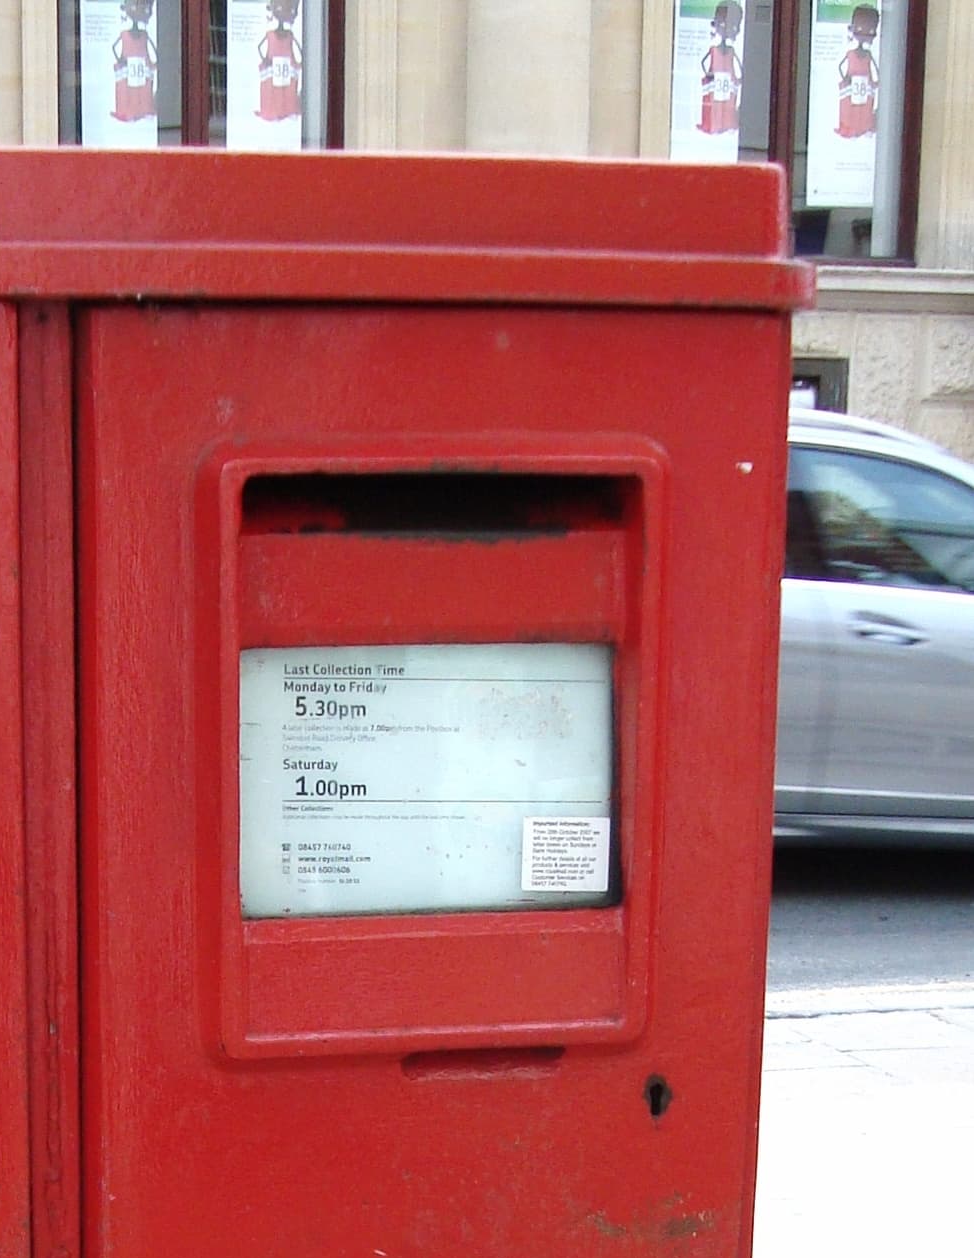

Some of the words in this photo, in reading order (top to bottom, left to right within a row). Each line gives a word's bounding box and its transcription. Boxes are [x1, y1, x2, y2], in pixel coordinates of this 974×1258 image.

[129, 63, 145, 78] 38
[274, 63, 290, 78] 38
[716, 79, 730, 92] 38
[853, 82, 867, 96] 38
[283, 664, 309, 676] Last
[313, 664, 372, 676] Collection
[377, 665, 405, 676] Time
[283, 681, 331, 695] Monday
[334, 683, 346, 693] to
[295, 696, 367, 720] 5.30pm
[283, 758, 338, 772] Saturday
[295, 775, 367, 799] 1.00pm
